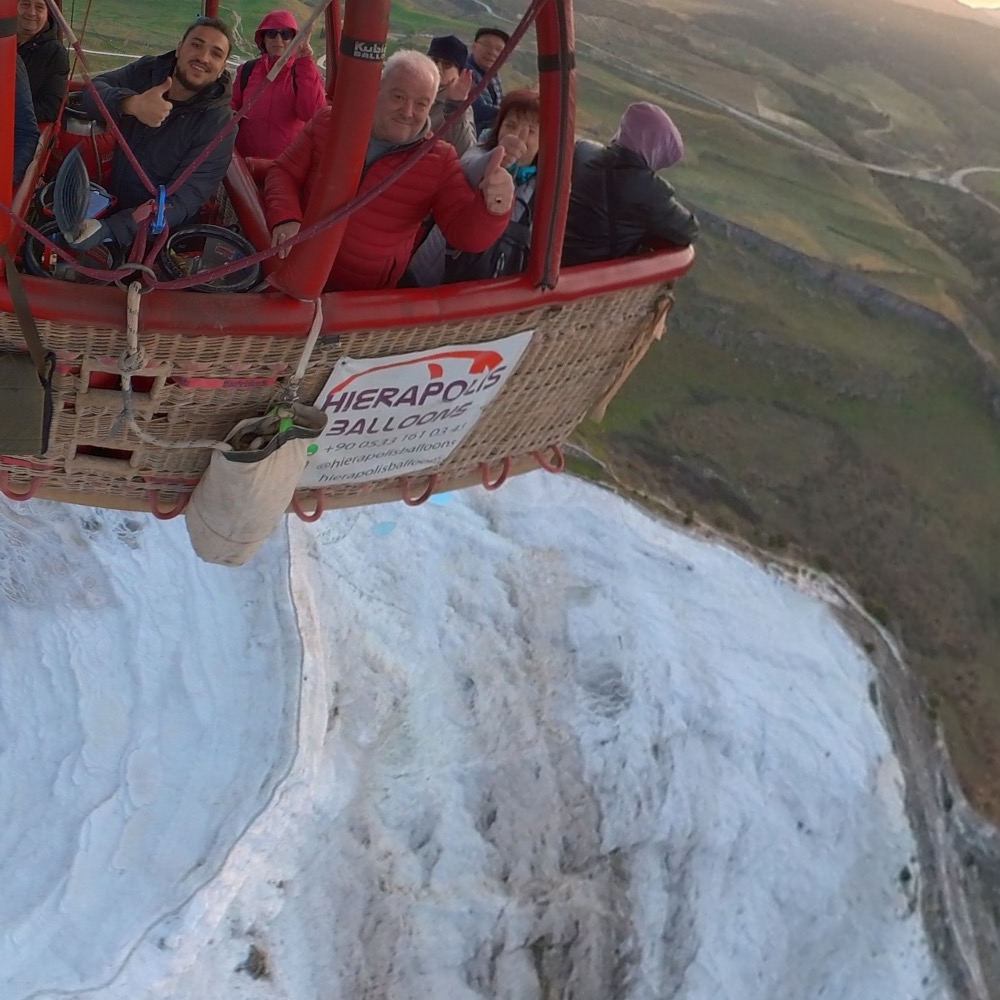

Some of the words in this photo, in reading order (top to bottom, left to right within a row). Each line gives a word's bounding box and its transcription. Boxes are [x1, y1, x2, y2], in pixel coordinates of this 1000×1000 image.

[321, 365, 507, 413] HIERAPOLIS
[326, 402, 472, 436] BALLOONS
[324, 442, 356, 453] +90
